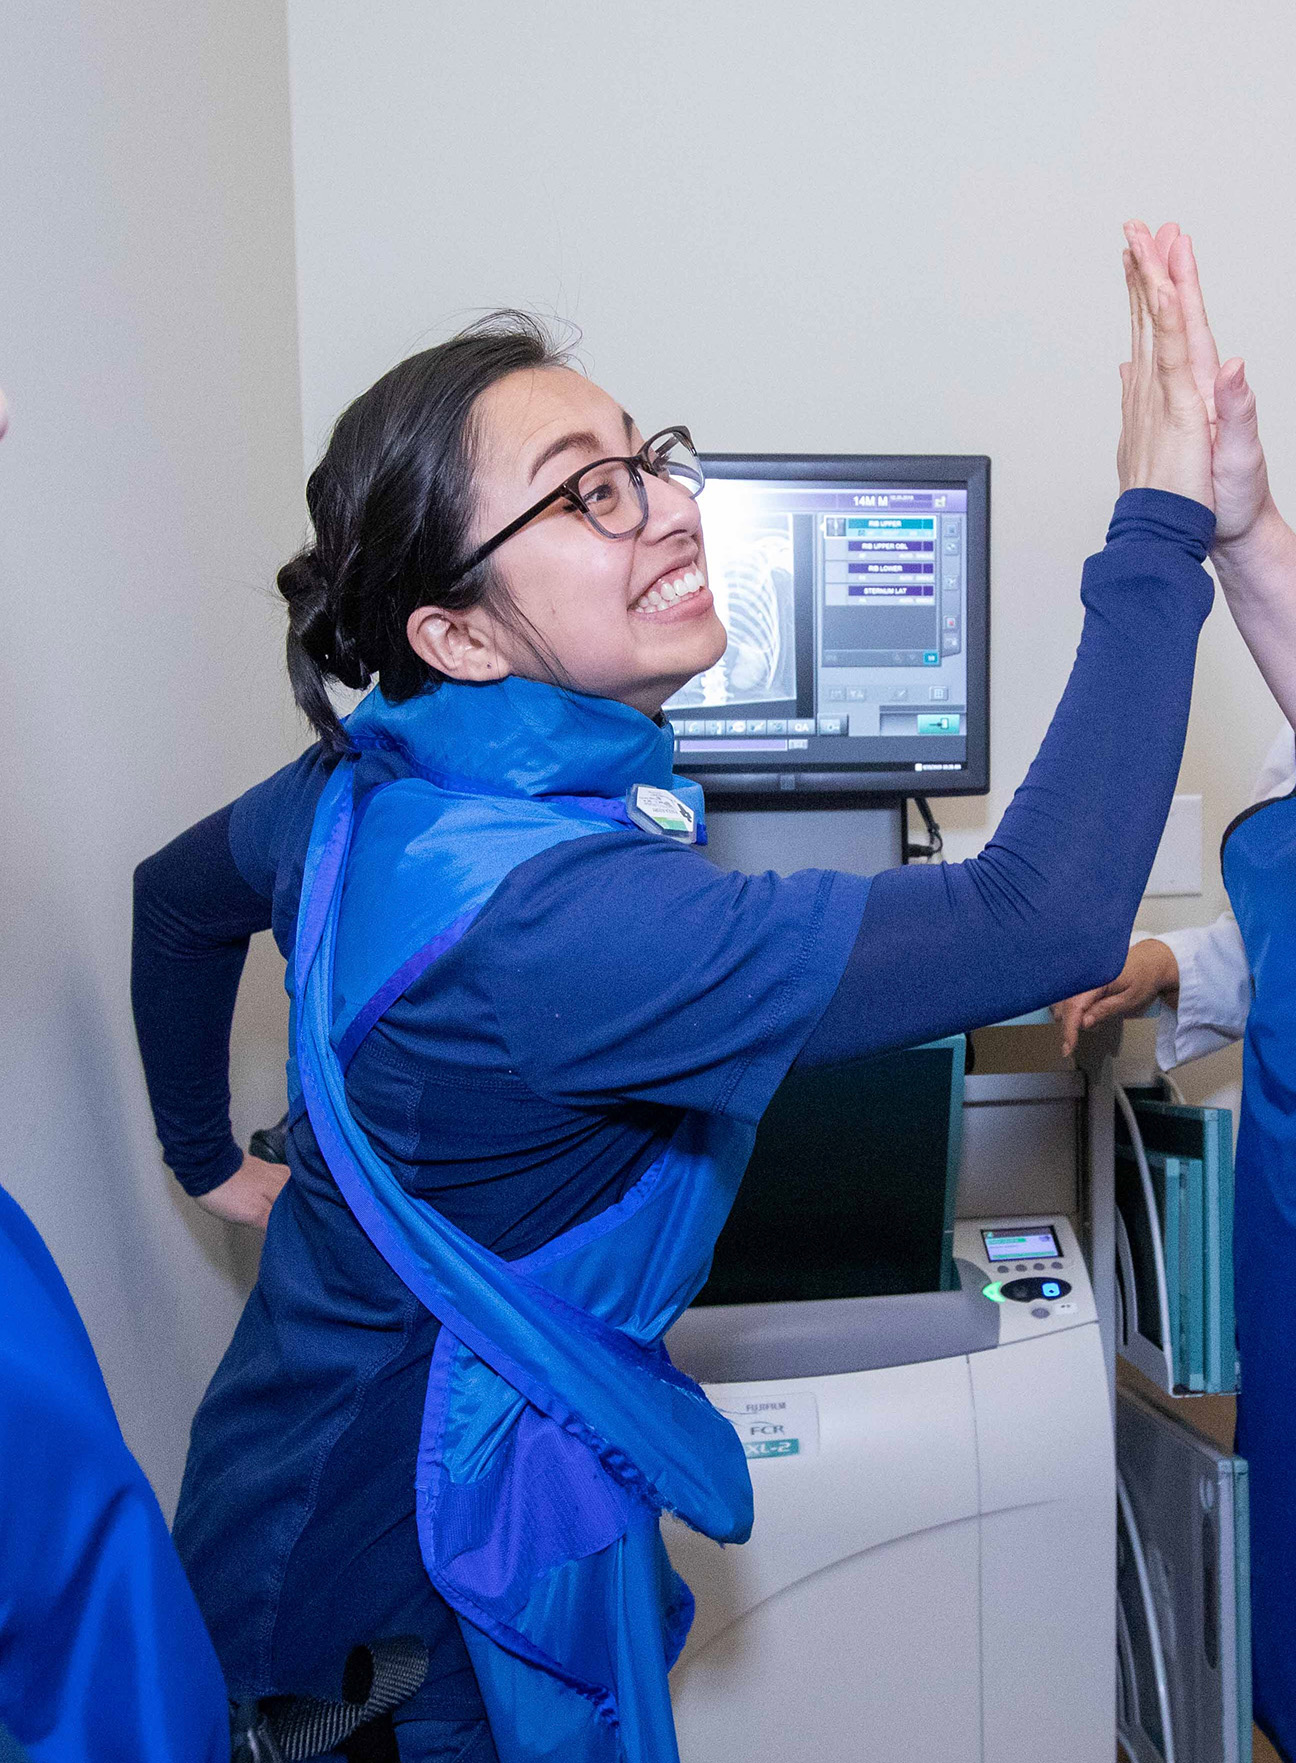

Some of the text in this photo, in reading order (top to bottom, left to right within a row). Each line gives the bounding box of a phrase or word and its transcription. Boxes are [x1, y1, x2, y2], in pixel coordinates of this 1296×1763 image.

[894, 587, 908, 595] LAT
[746, 1402, 787, 1412] FUJIFILM
[750, 1425, 784, 1435] FCR
[746, 1442, 791, 1455] XL-2
